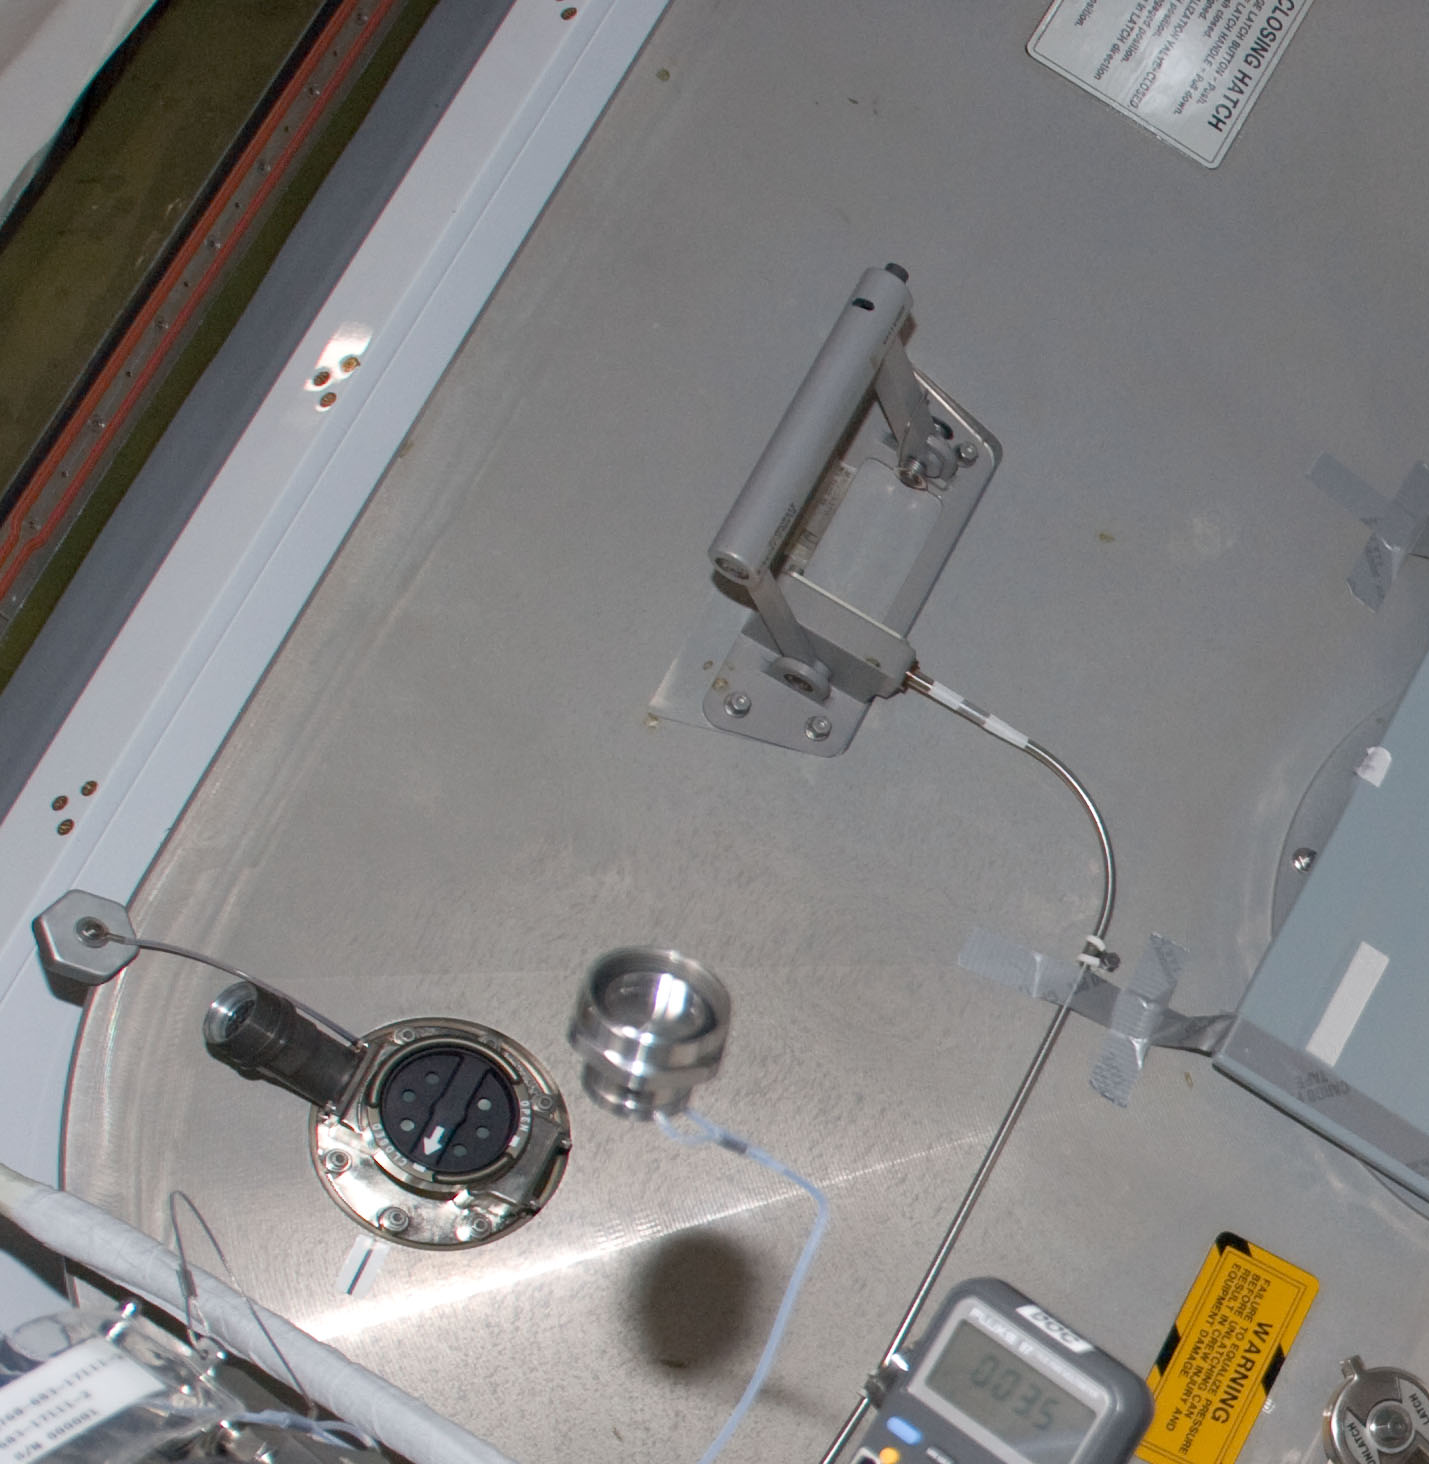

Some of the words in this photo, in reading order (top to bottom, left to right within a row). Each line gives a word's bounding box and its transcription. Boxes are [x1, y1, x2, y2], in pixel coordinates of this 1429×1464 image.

[1115, 10, 1140, 44] LATCH
[1222, 1, 1245, 32] LATCH
[1234, 9, 1257, 41] LATCH
[1093, 41, 1121, 82] direction
[1202, 30, 1228, 67] HANDLE
[1213, 38, 1240, 77] BUTTON
[1206, 67, 1253, 133] HATCH
[519, 1099, 531, 1131] OPEN
[372, 1123, 407, 1166] CLOSED
[1203, 1262, 1241, 1326] EQUIPMENT
[1223, 1267, 1251, 1311] RESULT
[1232, 1272, 1261, 1318] BEFORE
[1242, 1277, 1271, 1323] FAILURE
[1216, 1313, 1228, 1326] IN
[1233, 1325, 1247, 1341] TO
[1196, 1319, 1238, 1392] UNLATCHING
[1198, 1327, 1221, 1362] CREW
[1178, 1363, 1204, 1404] INJURY
[1207, 1342, 1239, 1395] EQUALIZE
[1209, 1318, 1273, 1425] WARNING
[1164, 1406, 1183, 1432] AND
[1177, 1397, 1212, 1455] PRESSURE
[1183, 1392, 1202, 1419] CAN
